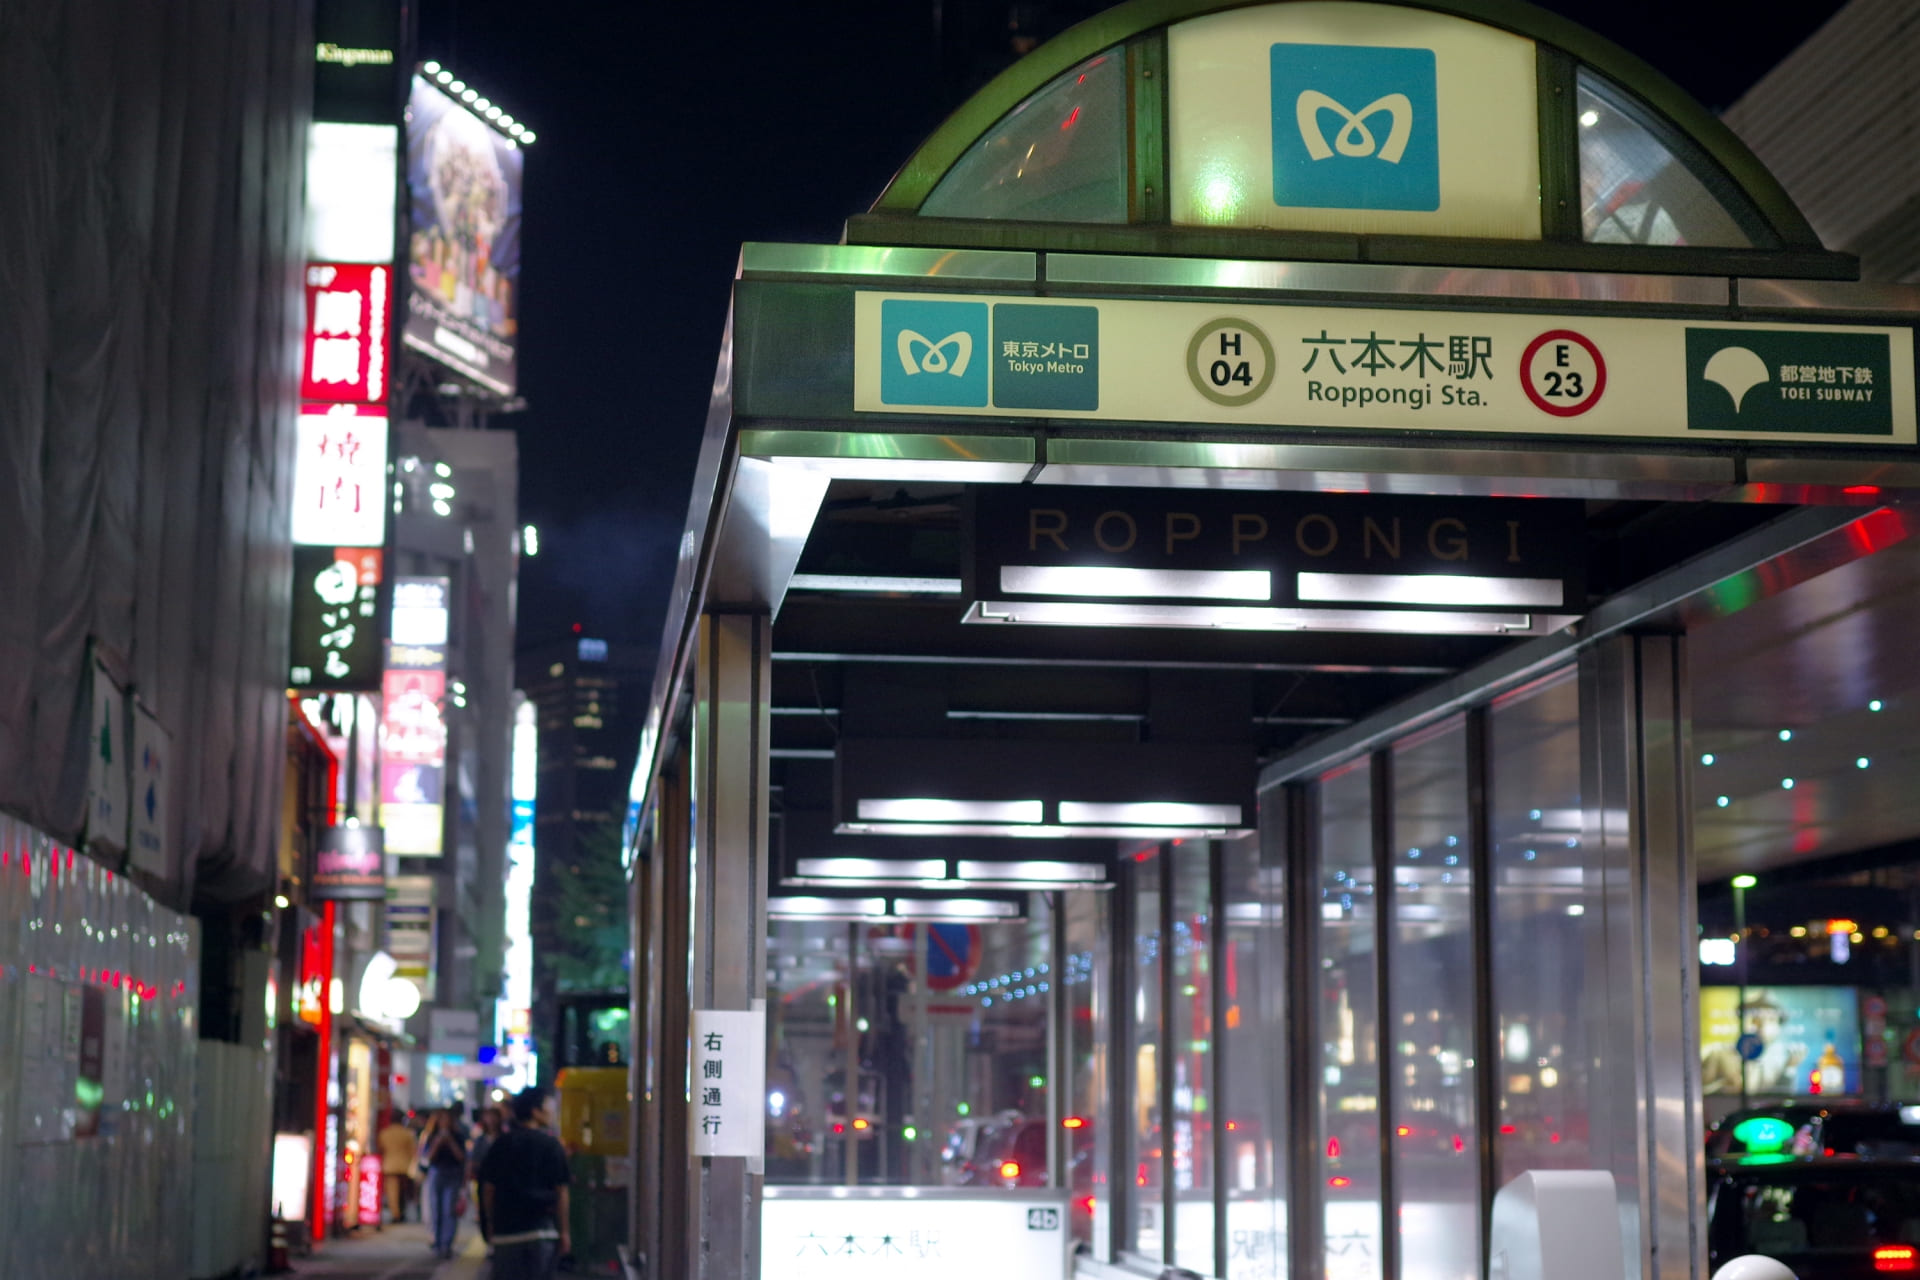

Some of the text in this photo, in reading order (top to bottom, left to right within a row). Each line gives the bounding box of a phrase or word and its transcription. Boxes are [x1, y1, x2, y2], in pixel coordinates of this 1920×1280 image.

[1002, 341, 1089, 359] 東京メトロ
[1220, 332, 1241, 356] H
[1302, 329, 1494, 381] 六本木駅
[1556, 344, 1570, 367] E
[1008, 359, 1084, 375] Tokyo Metro
[1210, 360, 1253, 387] 04
[1780, 364, 1873, 385] 都営地下鉄
[1308, 380, 1488, 410] Roppongi Sta.
[1544, 371, 1584, 398] 23
[1780, 387, 1873, 402] TOEI SUBWAY
[1029, 507, 1522, 564] ROPPONGI
[702, 1031, 724, 1135] 右側通行
[1029, 1210, 1058, 1228] 4b
[796, 1229, 942, 1259] 六本木駅
